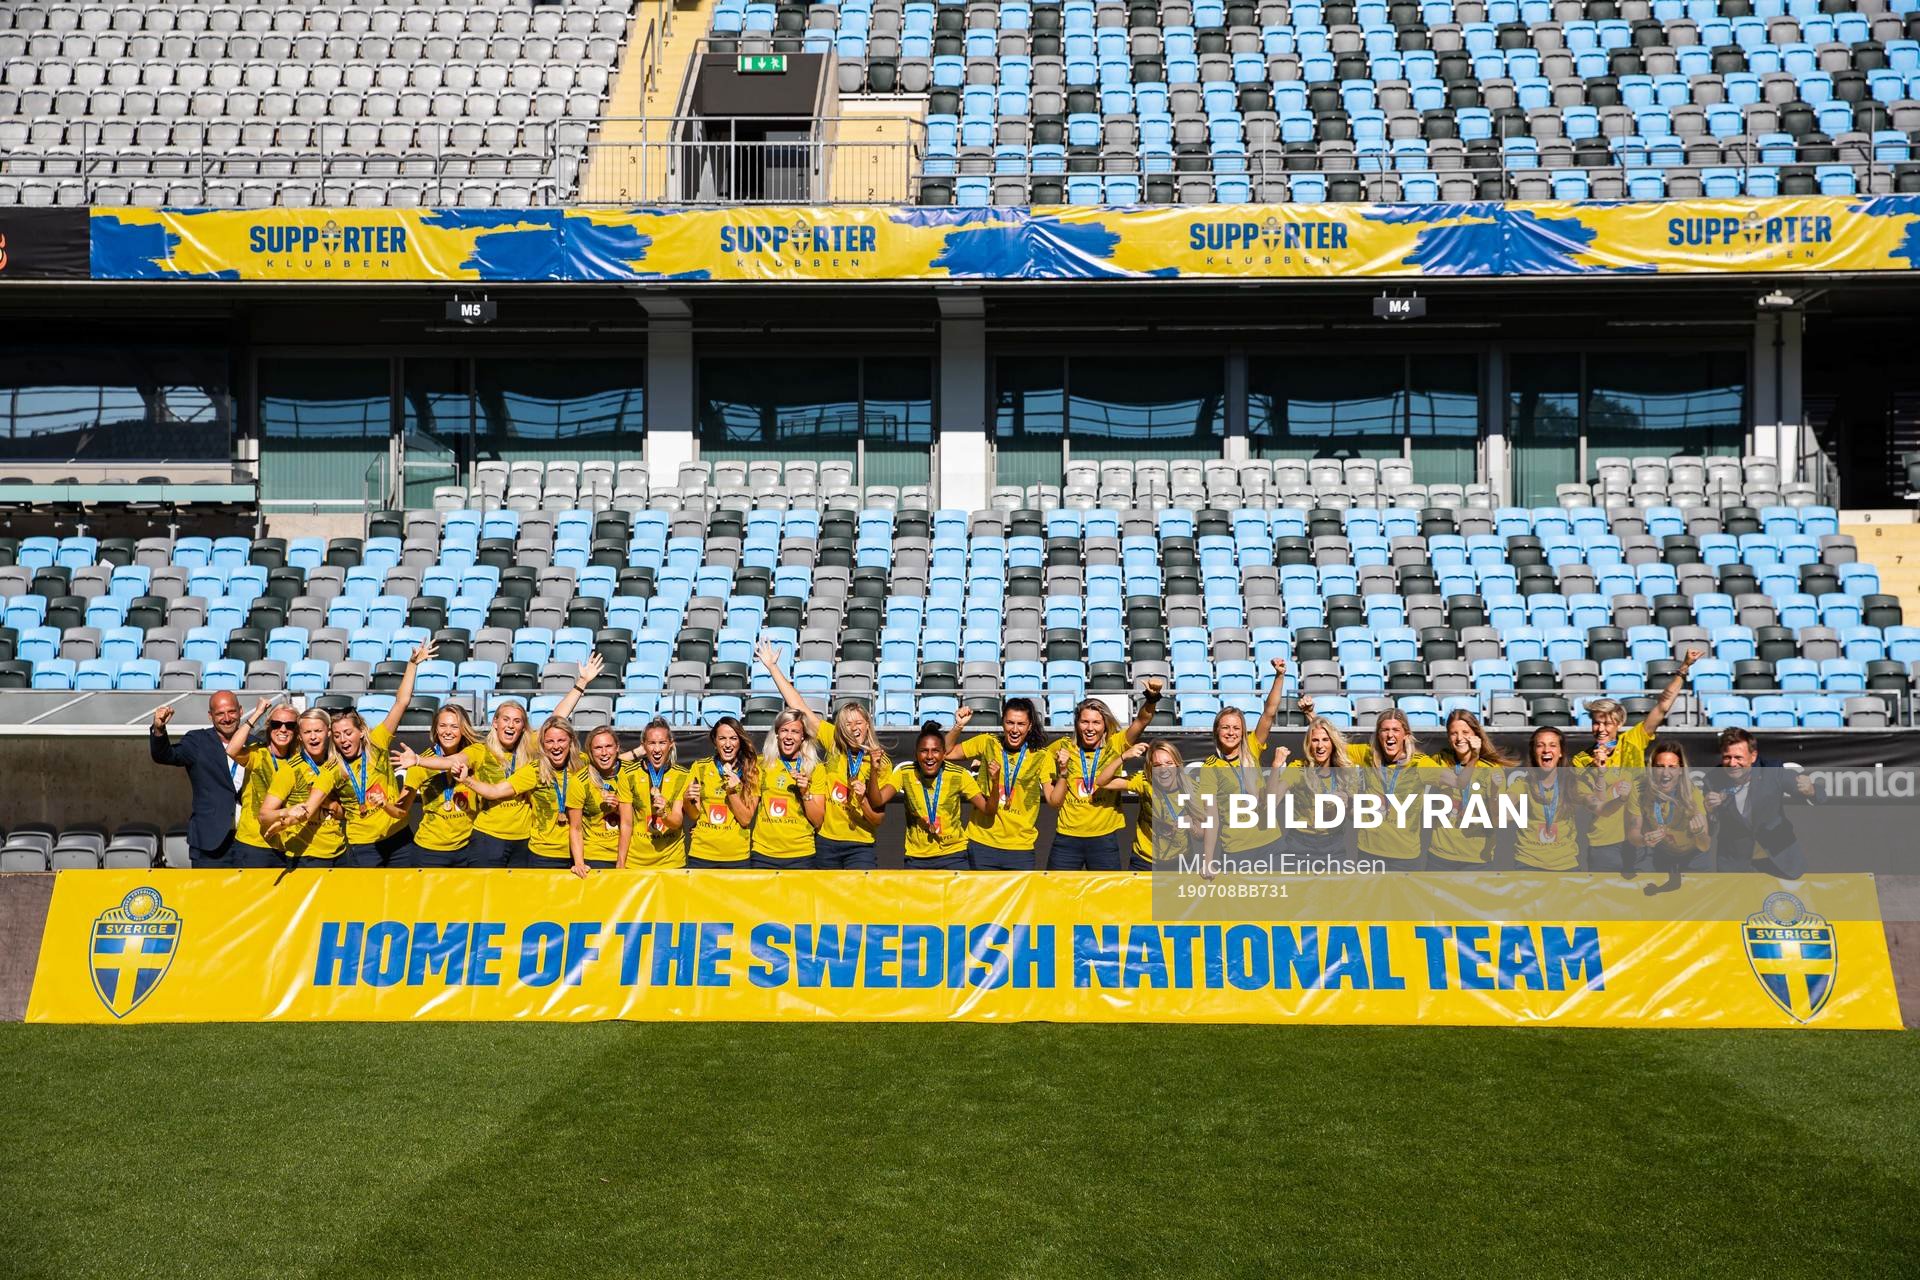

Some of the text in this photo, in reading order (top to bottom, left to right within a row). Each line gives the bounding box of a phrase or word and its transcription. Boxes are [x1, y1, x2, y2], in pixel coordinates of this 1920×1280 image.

[266, 259, 390, 268] KLUBBEN
[1206, 256, 1331, 265] KLUBBEN
[461, 304, 481, 316] M5
[1389, 300, 1410, 313] M4
[1783, 762, 1915, 798] amla
[105, 924, 168, 934] SVERIGE
[1756, 929, 1821, 940] SVERIGE
[313, 921, 1605, 991] HOME OF THE SWEDISH NATIONAL TEAM
